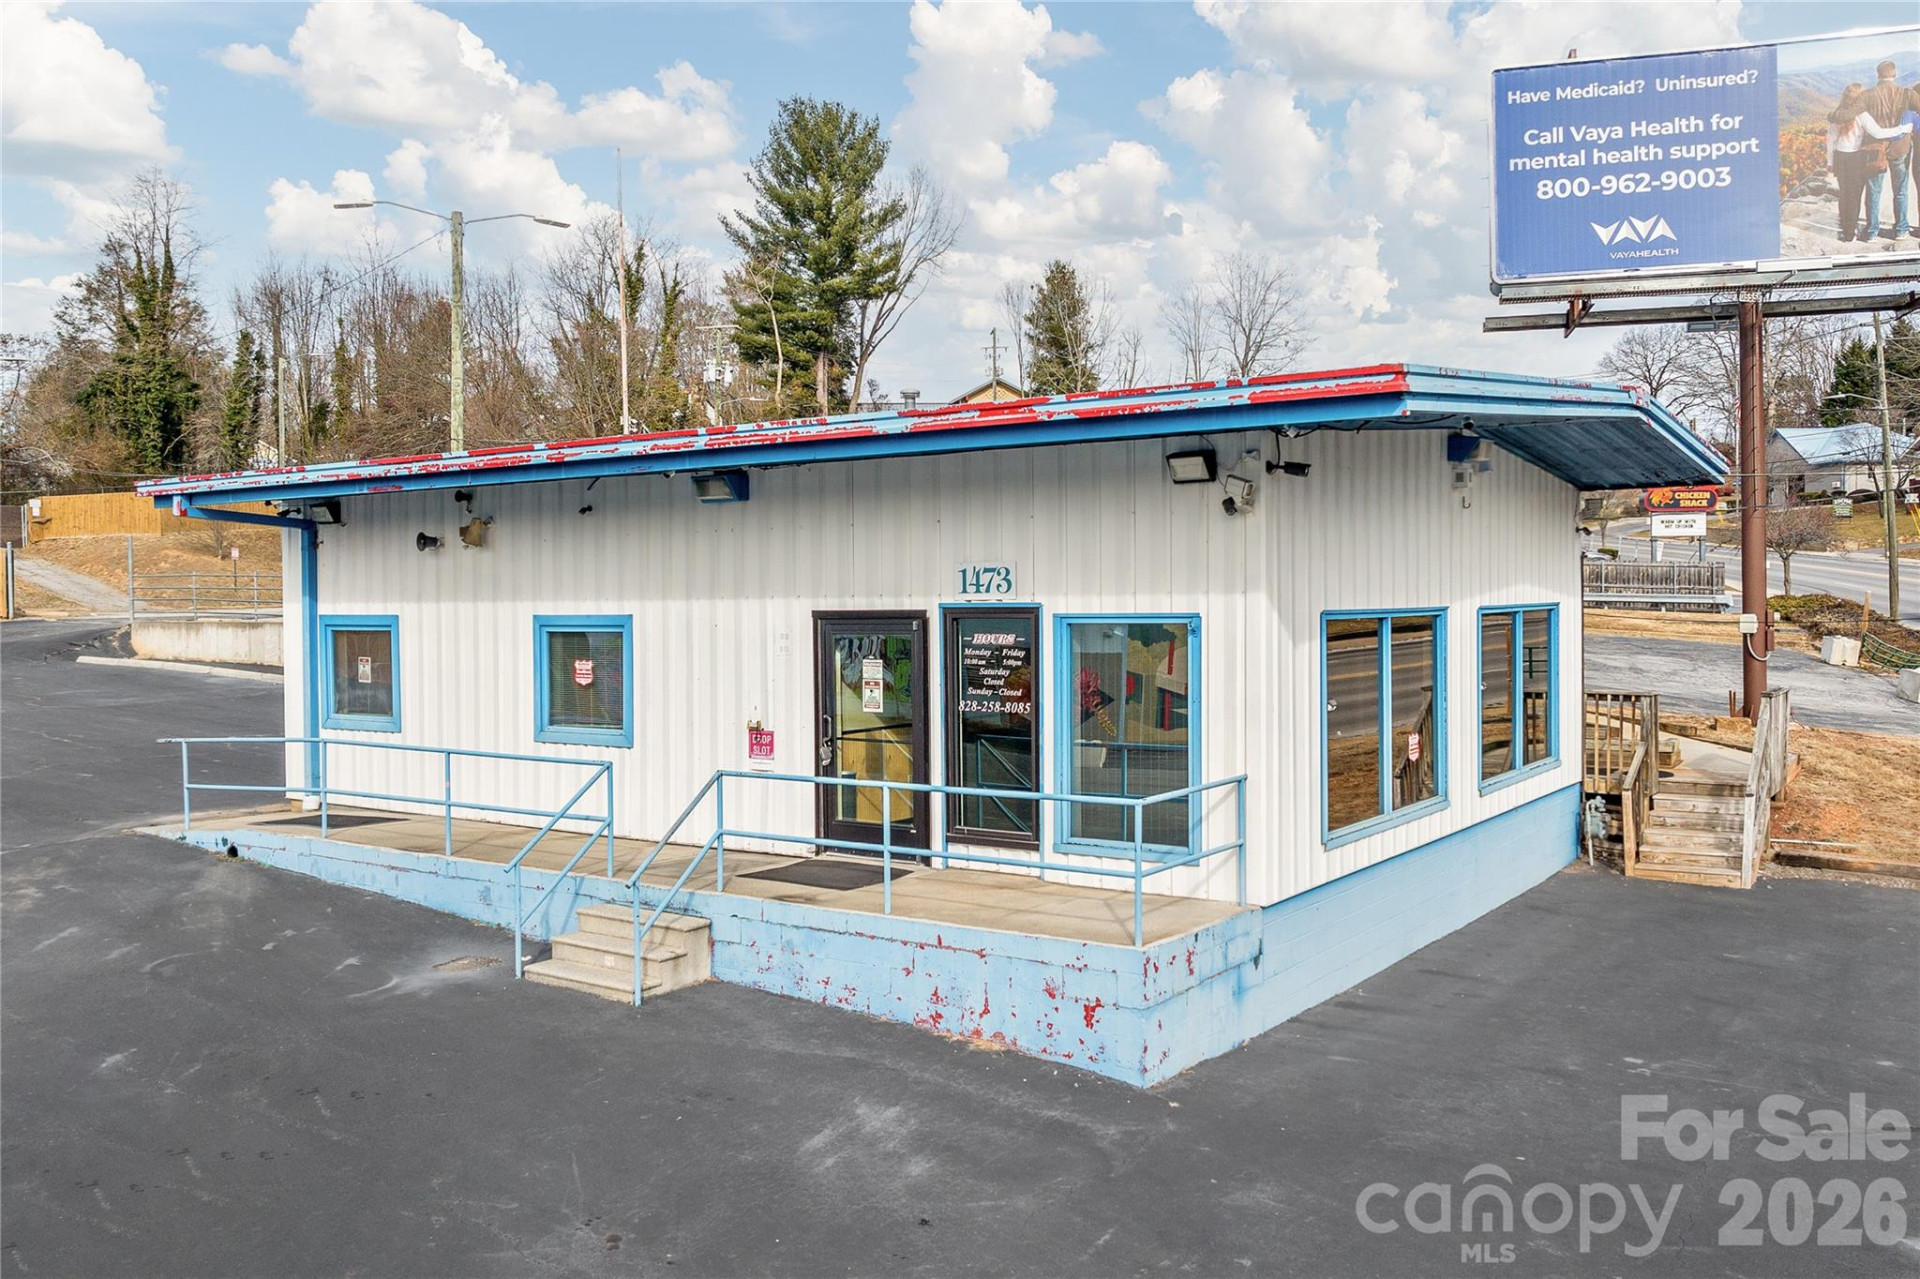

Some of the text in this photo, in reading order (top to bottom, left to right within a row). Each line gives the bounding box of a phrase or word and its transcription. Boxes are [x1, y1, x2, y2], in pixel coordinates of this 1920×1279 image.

[1507, 69, 1759, 105] Have Medicaid? Uninsured?
[1523, 113, 1744, 146] Call Vaya Health for
[1509, 137, 1760, 171] mental health support
[1536, 166, 1732, 200] 800-962-9003
[1610, 247, 1680, 260] VAYAHEALTH
[1674, 491, 1711, 499] CHICKEN
[1679, 499, 1708, 507] SHACK
[958, 565, 1013, 594] 1473
[972, 633, 1017, 645] HOURS
[964, 648, 992, 657] Monday
[1002, 648, 1026, 658] Friday
[979, 667, 1011, 677] Saturday
[983, 677, 1005, 686] Closed
[967, 687, 993, 697] Sunday
[998, 688, 1023, 696] Closed
[958, 700, 1031, 714] 828-258-8085
[752, 745, 772, 755] SLOT
